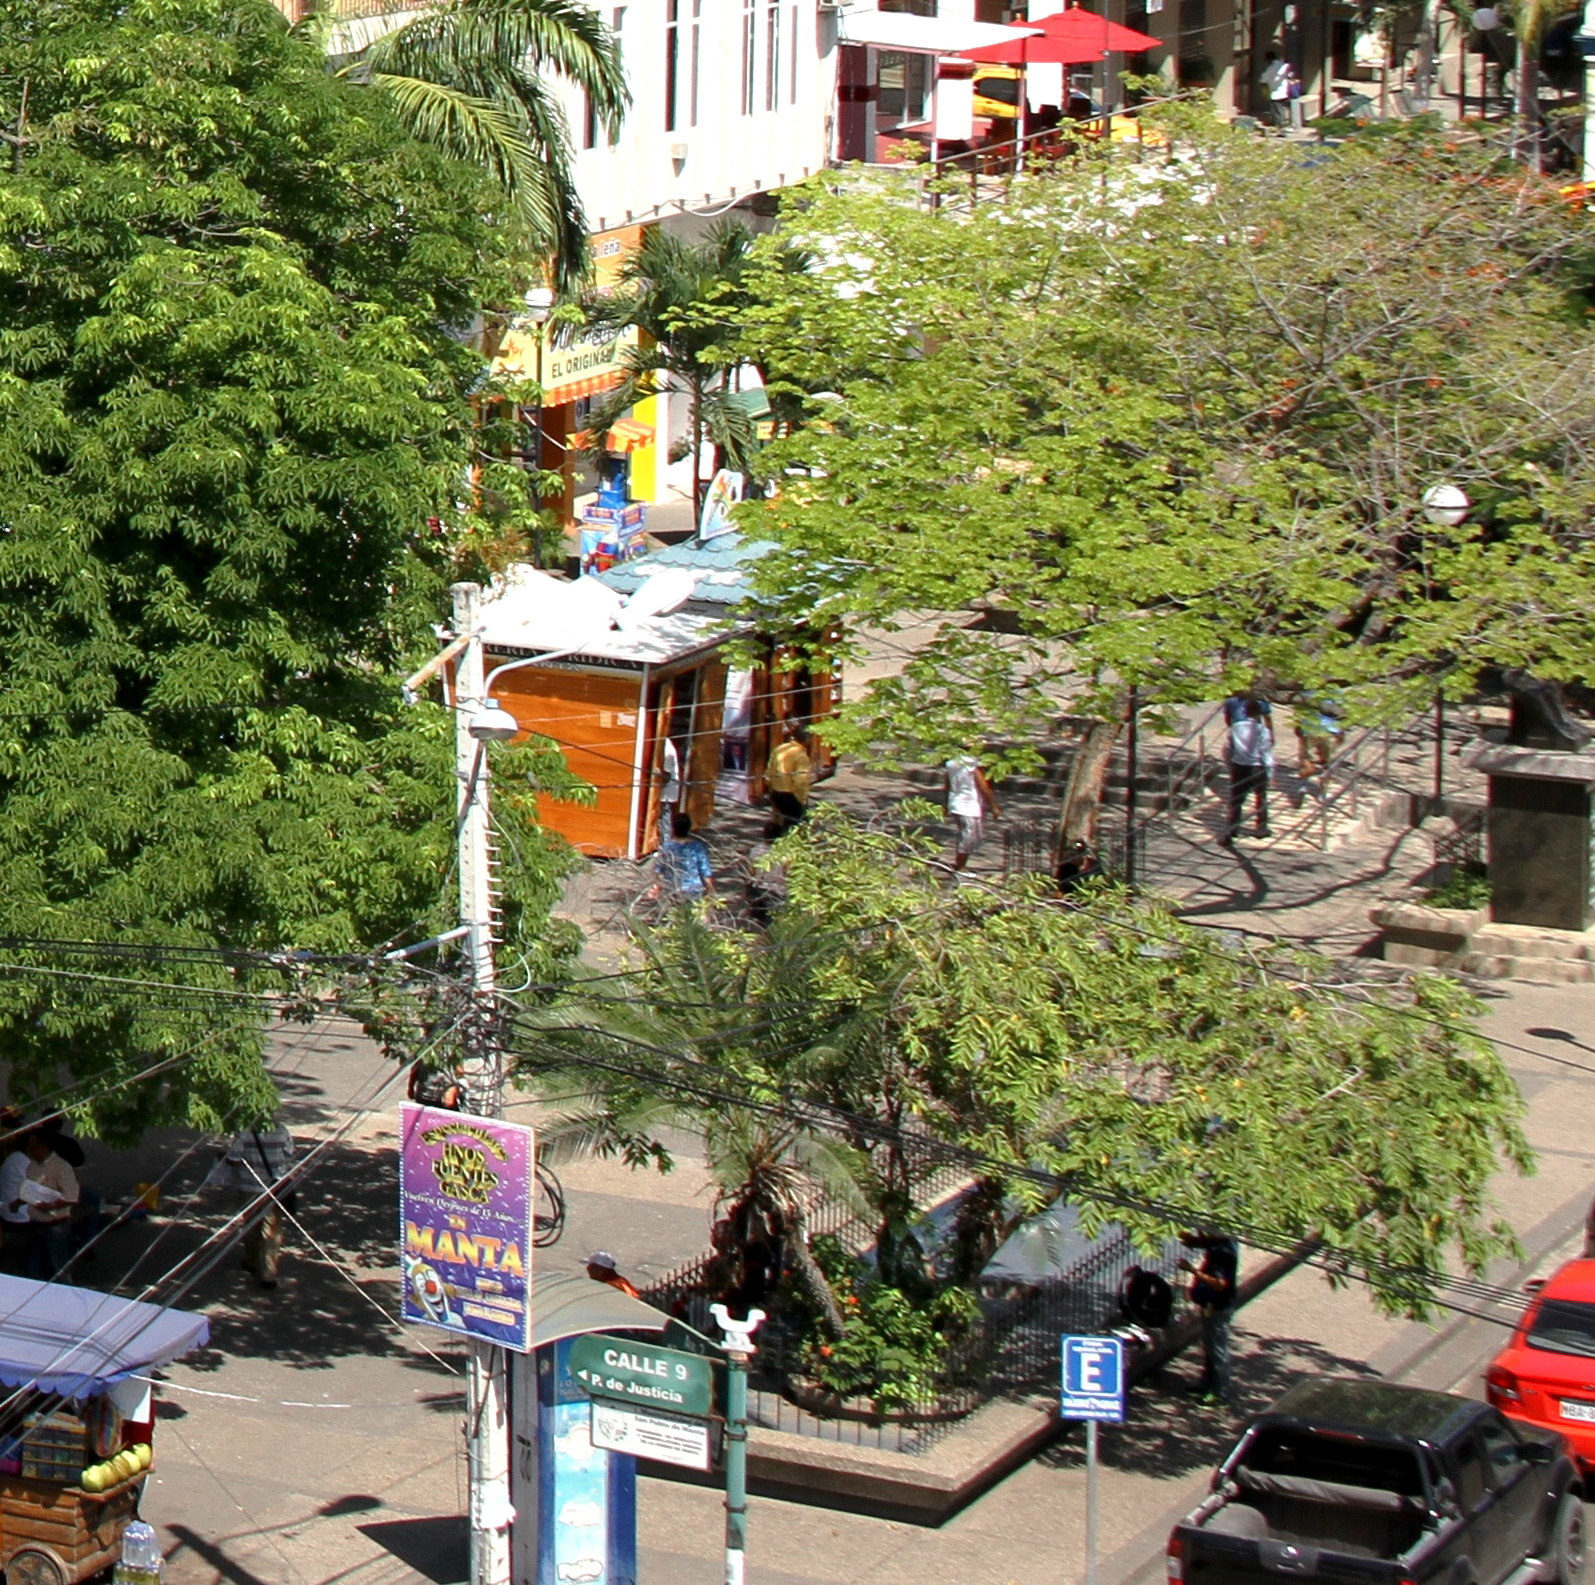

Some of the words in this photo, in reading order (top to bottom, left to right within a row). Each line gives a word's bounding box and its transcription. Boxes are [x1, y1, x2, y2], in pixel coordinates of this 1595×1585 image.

[552, 362, 563, 378] EL
[442, 1141, 486, 1167] HNOS
[431, 1158, 500, 1187] FUENTES
[439, 1180, 490, 1204] GASCA
[405, 1220, 525, 1277] MANTA
[603, 1349, 669, 1377] CALLE
[675, 1363, 688, 1381] 9
[1080, 1352, 1102, 1392] E
[590, 1373, 603, 1388] P.
[605, 1377, 624, 1392] de
[626, 1381, 684, 1404] Justicia
